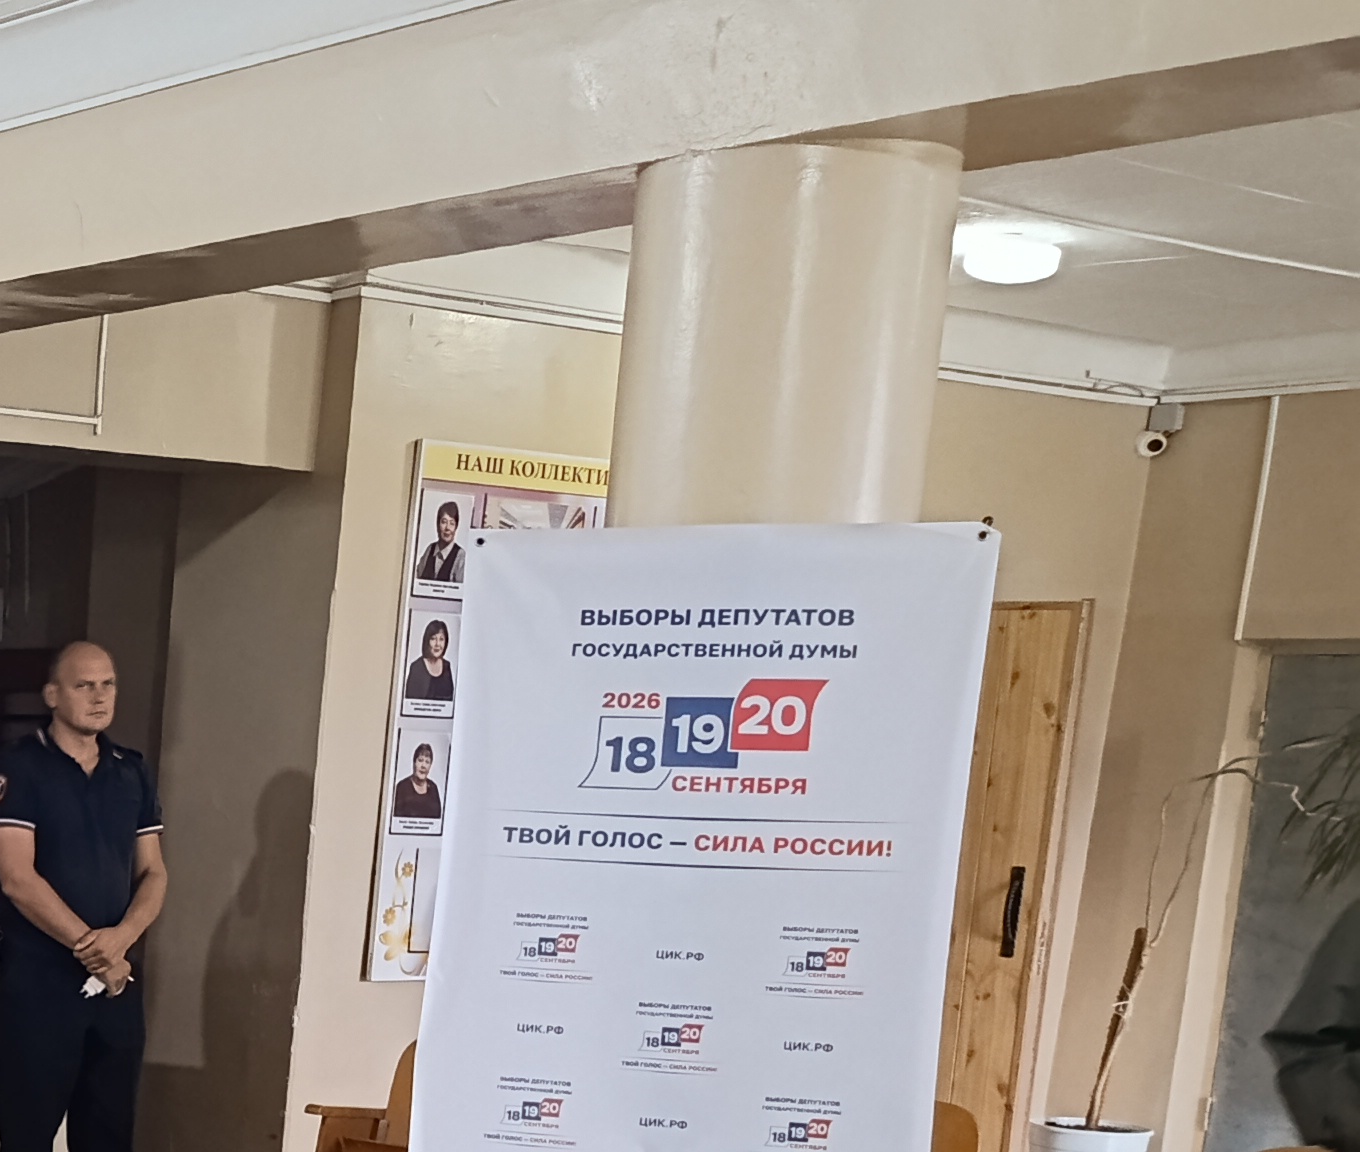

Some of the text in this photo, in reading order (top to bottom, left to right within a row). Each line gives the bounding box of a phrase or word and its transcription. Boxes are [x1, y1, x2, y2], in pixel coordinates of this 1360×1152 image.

[456, 453, 609, 485] НАШ КОЛЛЕКТИ
[580, 608, 855, 629] ВЫБОРЫ ДЕПУТАТОВ
[571, 639, 858, 661] ГОСУДАРСТВЕННОЙ ДУМЫ
[601, 692, 661, 710] 2026
[605, 694, 807, 774] 18 19 20
[671, 775, 807, 795] СЕНТЯБРЯ
[502, 824, 571, 846] ТВОЙ
[577, 830, 663, 850] ГОЛОС
[694, 834, 765, 854] СИЛА
[773, 837, 892, 858] РОССИИ!
[523, 938, 575, 957] 18 19 20
[655, 950, 705, 962] ЦИК.РФ
[790, 952, 845, 972] 18 19 20
[516, 1023, 564, 1035] ЦИК.РФ
[646, 1028, 699, 1047] 18 19 20
[783, 1040, 834, 1053] ЦИК.РФ
[507, 1103, 559, 1121] 18 19 20
[638, 1117, 688, 1130] ЦИК.РФ
[772, 1124, 827, 1143] 18 19 20
